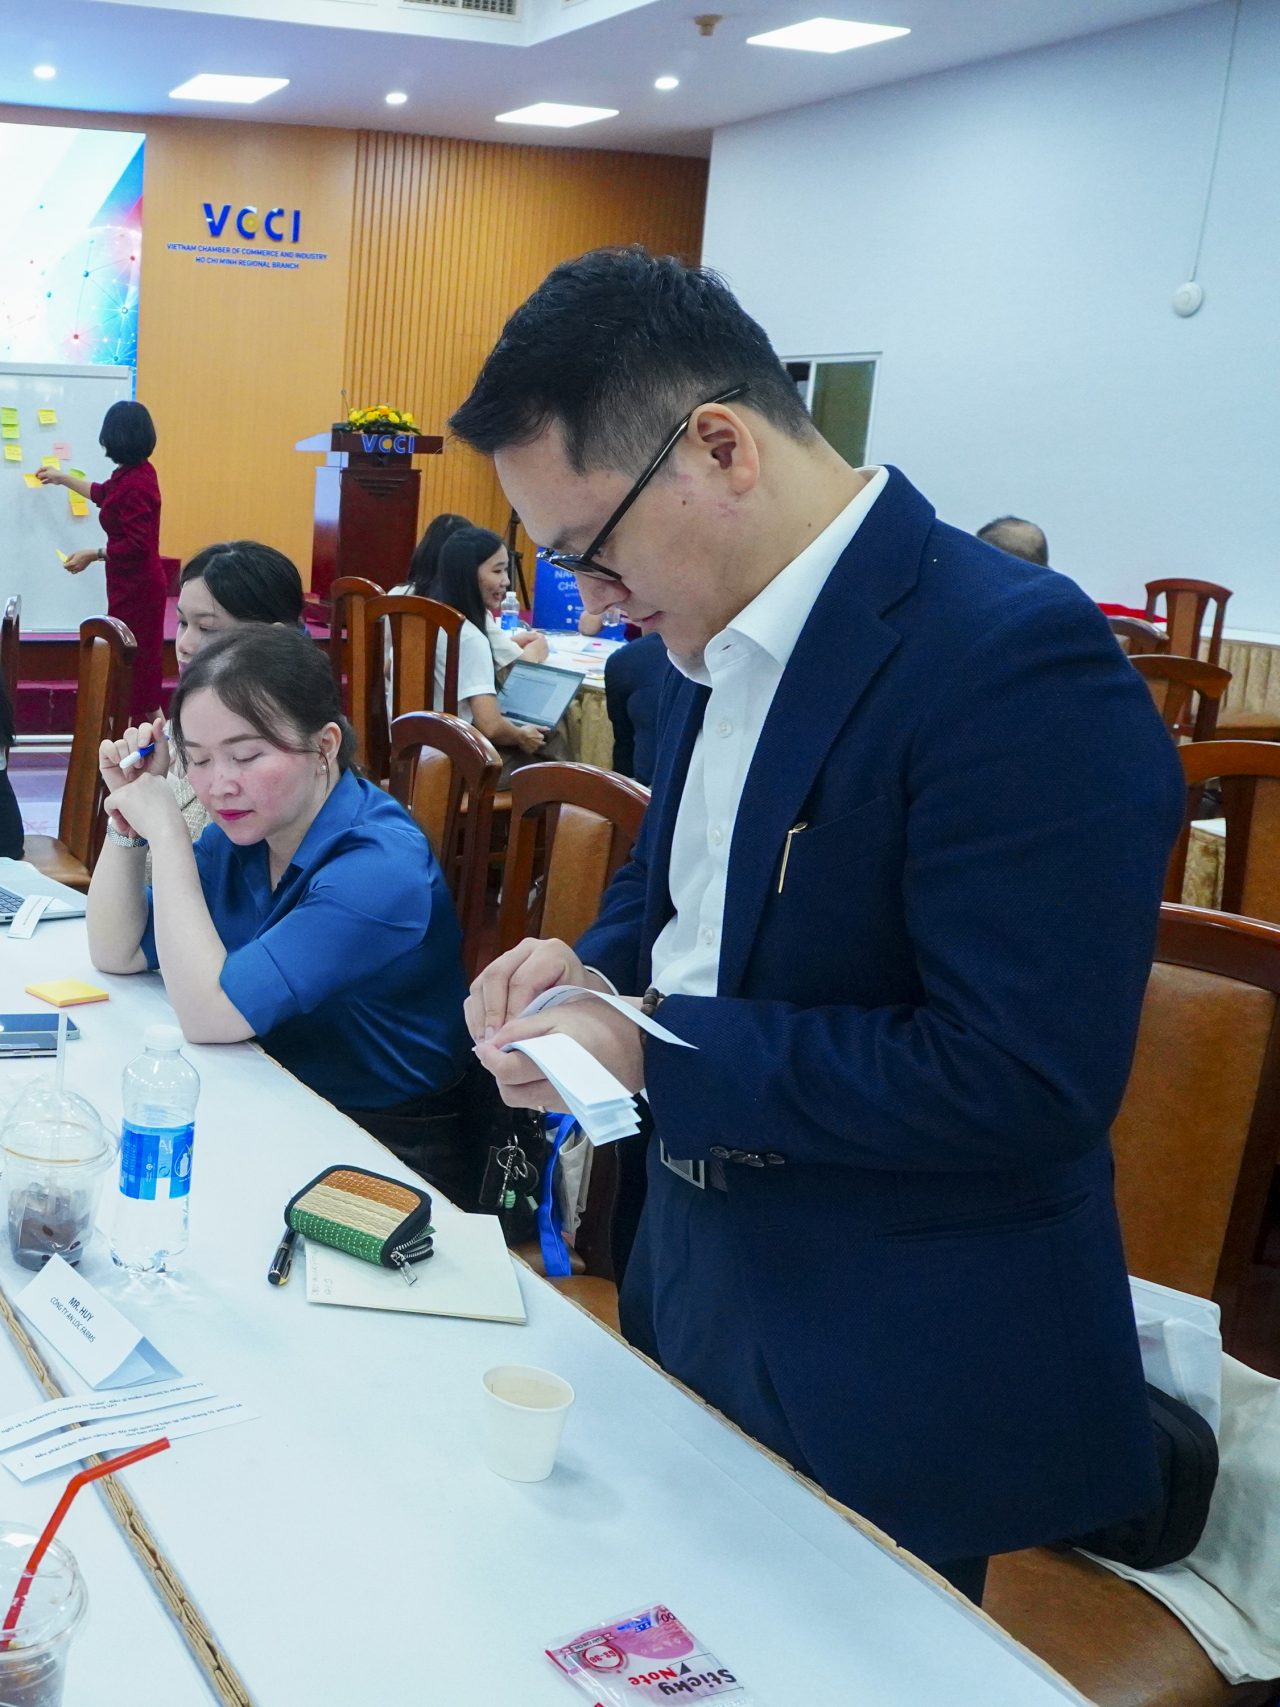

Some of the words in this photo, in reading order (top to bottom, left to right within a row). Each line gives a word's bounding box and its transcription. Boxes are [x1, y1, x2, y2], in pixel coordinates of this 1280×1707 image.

[202, 203, 301, 243] VCCI
[167, 243, 196, 251] VIETNAM
[198, 245, 231, 253] CHAMBER
[241, 248, 278, 258] COMMERCE
[295, 252, 327, 260] INDUSTRY
[239, 259, 270, 267] REGIONAL
[272, 261, 299, 269] BRANCH
[361, 434, 415, 454] VCCI
[79, 1306, 94, 1322] HUY
[628, 1666, 678, 1686] Note
[657, 1668, 737, 1696] Sticky
